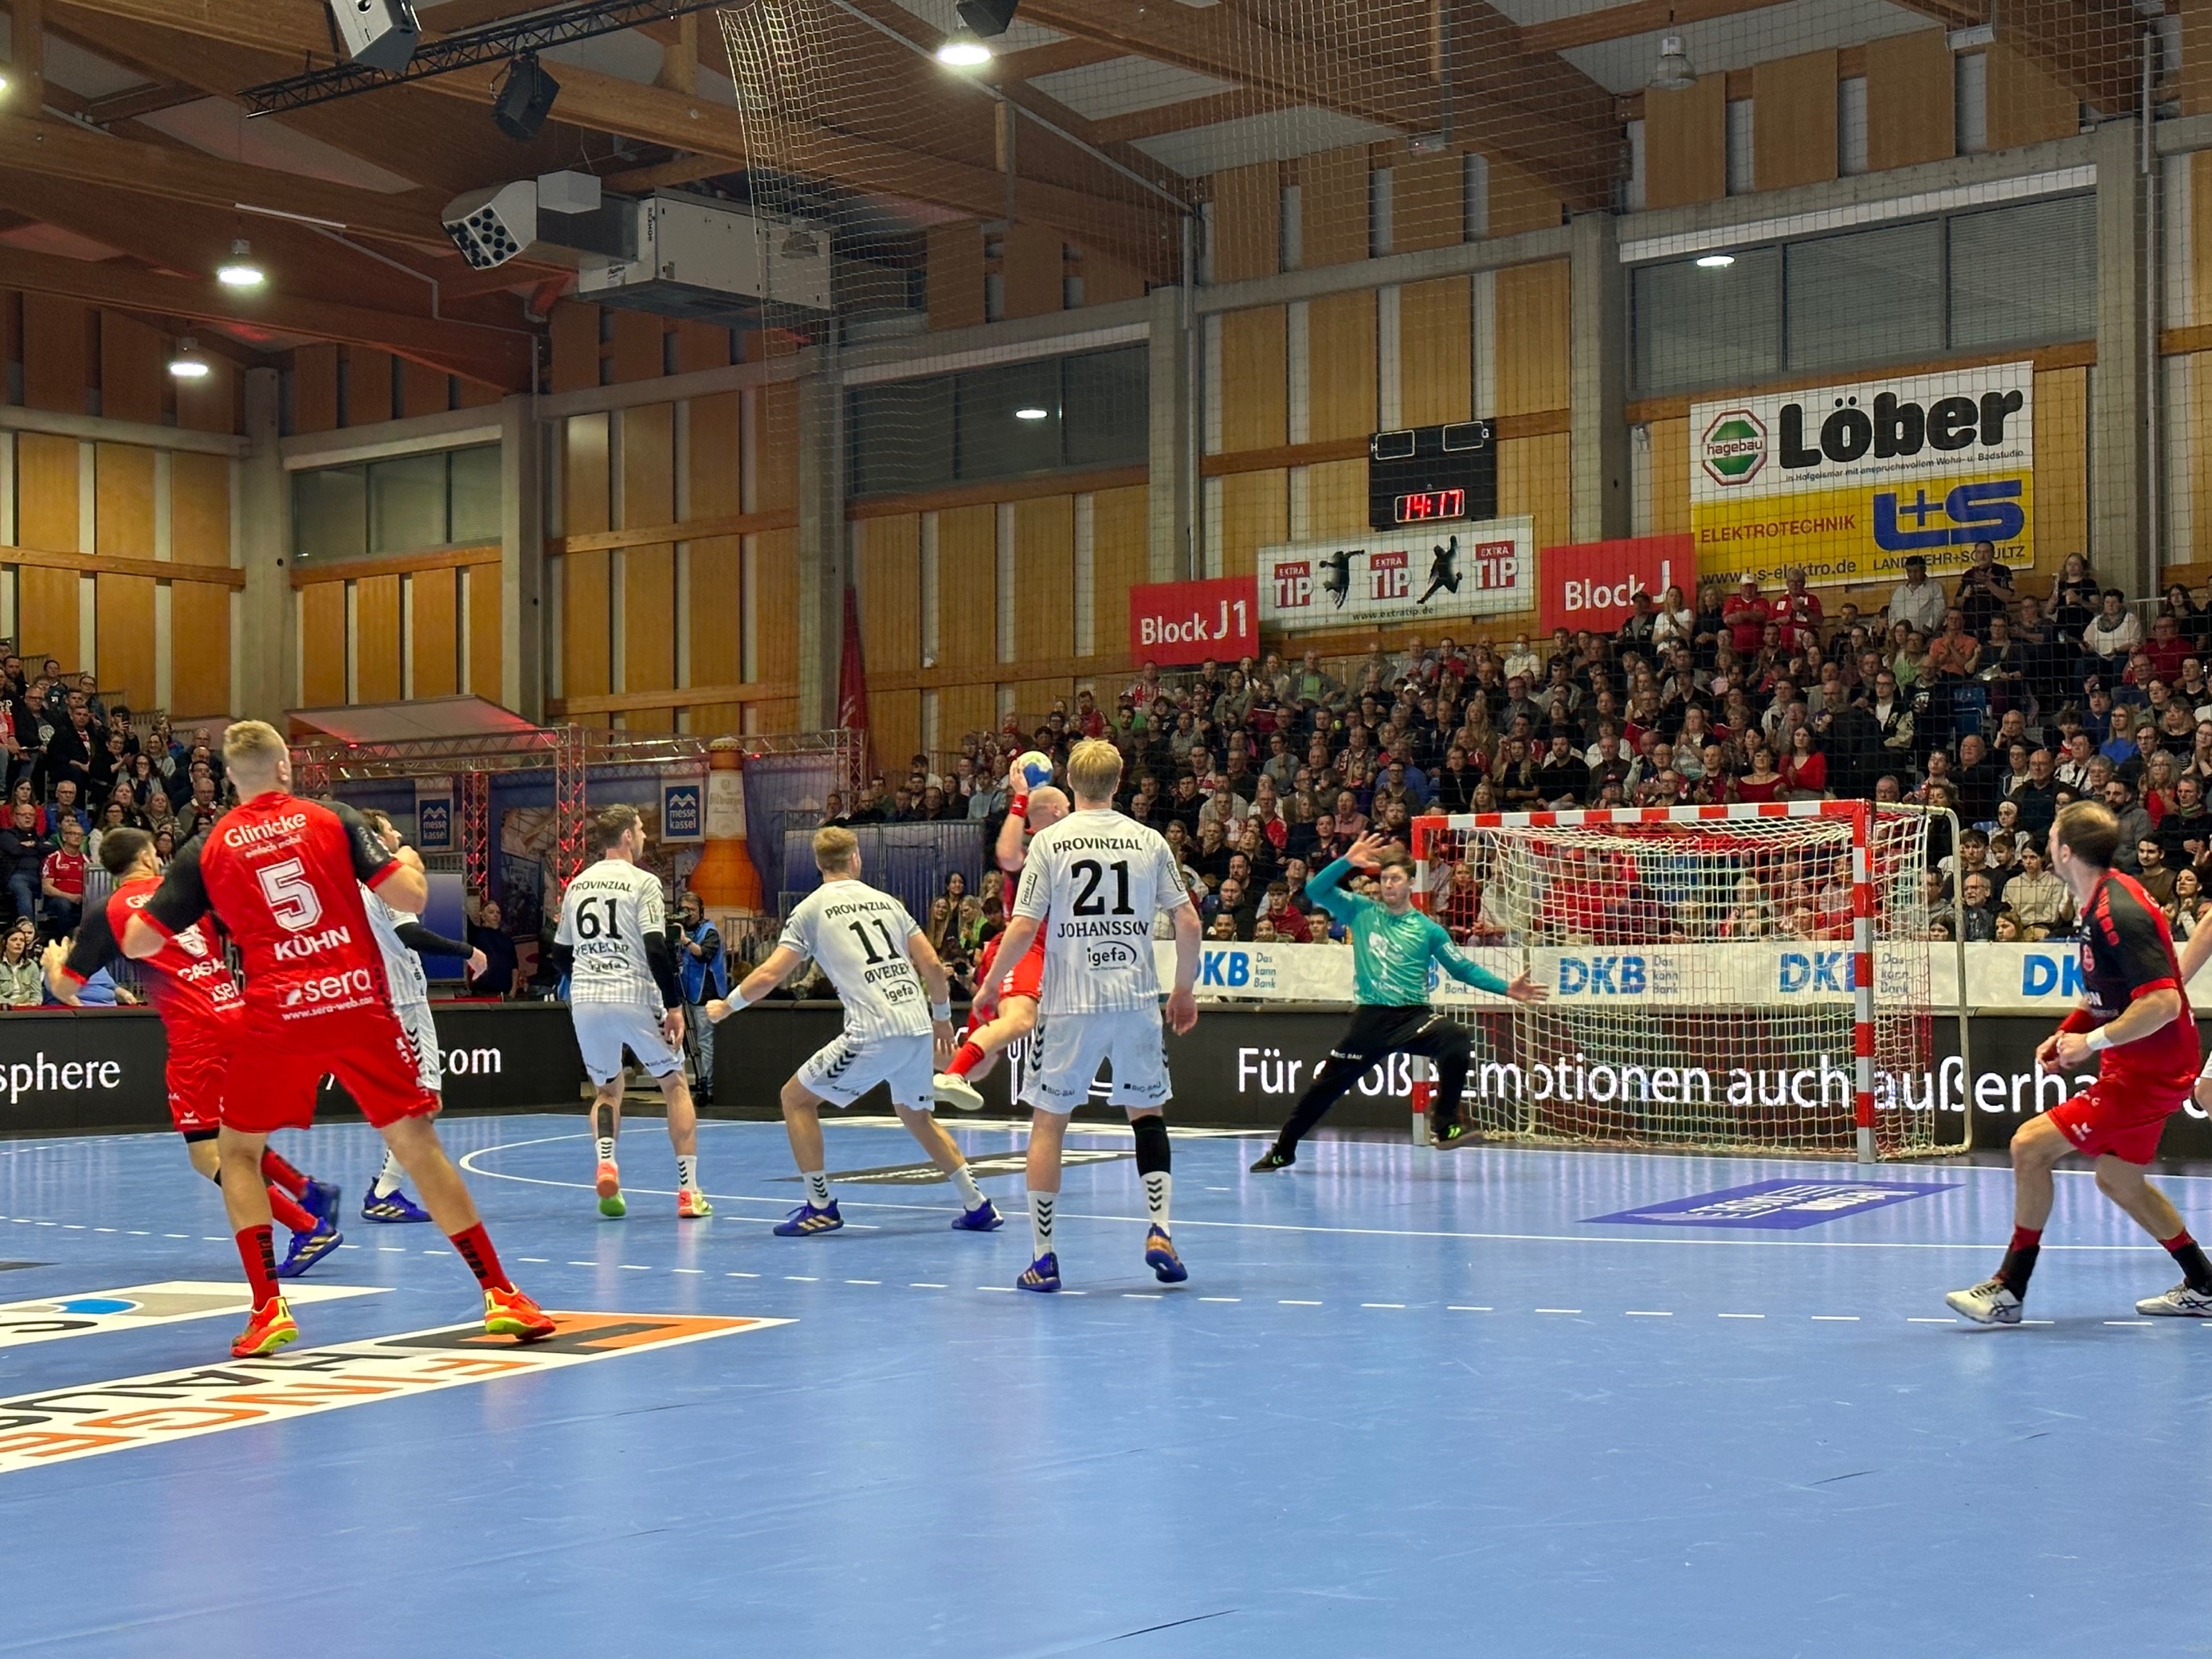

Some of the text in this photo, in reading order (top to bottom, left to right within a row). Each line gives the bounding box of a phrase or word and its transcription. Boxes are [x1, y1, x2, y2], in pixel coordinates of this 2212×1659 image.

[1779, 390, 2023, 469] Löber
[1707, 440, 1763, 457] hagebau
[1796, 470, 1843, 482] Hofgeismar
[1978, 449, 2024, 462] Badstudio
[1404, 488, 1461, 520] 14:17
[1701, 514, 1856, 543] ELEKTROTECHNIK
[1375, 556, 1402, 568] EXTRA
[1480, 546, 1509, 556] EXTRA
[1279, 566, 1305, 577] EXTRA
[1369, 567, 1411, 599] TIP
[1474, 557, 1518, 590] TIP
[1273, 576, 1312, 608] TIP
[1565, 574, 1645, 611] Block
[1653, 560, 1670, 604] J
[1141, 600, 1247, 645] Block J1
[1352, 606, 1433, 622] www.extratip.de
[423, 821, 447, 830] messe
[670, 810, 696, 818] messe
[670, 818, 696, 830] kassel
[225, 813, 307, 847] Glinicke
[423, 829, 447, 840] kassel
[1053, 837, 1143, 854] PROVINZIAL
[256, 857, 323, 931] 5
[1071, 859, 1135, 916] 21
[576, 896, 622, 939] 61
[273, 926, 351, 961] KÜHN
[849, 919, 900, 965] 11
[1087, 947, 1127, 967] igefa
[1195, 951, 1249, 987] KB
[1256, 952, 1273, 963] Das
[1653, 955, 1673, 967] Das
[1881, 953, 1904, 965] Das
[1253, 977, 1277, 989] Bank
[1255, 967, 1277, 976] kann
[1559, 955, 1646, 995] DKB
[1653, 969, 1678, 981] kann
[304, 968, 372, 1002] sera
[883, 984, 914, 1002] igefa
[1445, 982, 1469, 994] Bank
[1653, 983, 1678, 994] Bank
[282, 996, 375, 1021] www.sera-web.com
[1239, 1048, 1302, 1093] Für
[1727, 1054, 1849, 1108] auch
